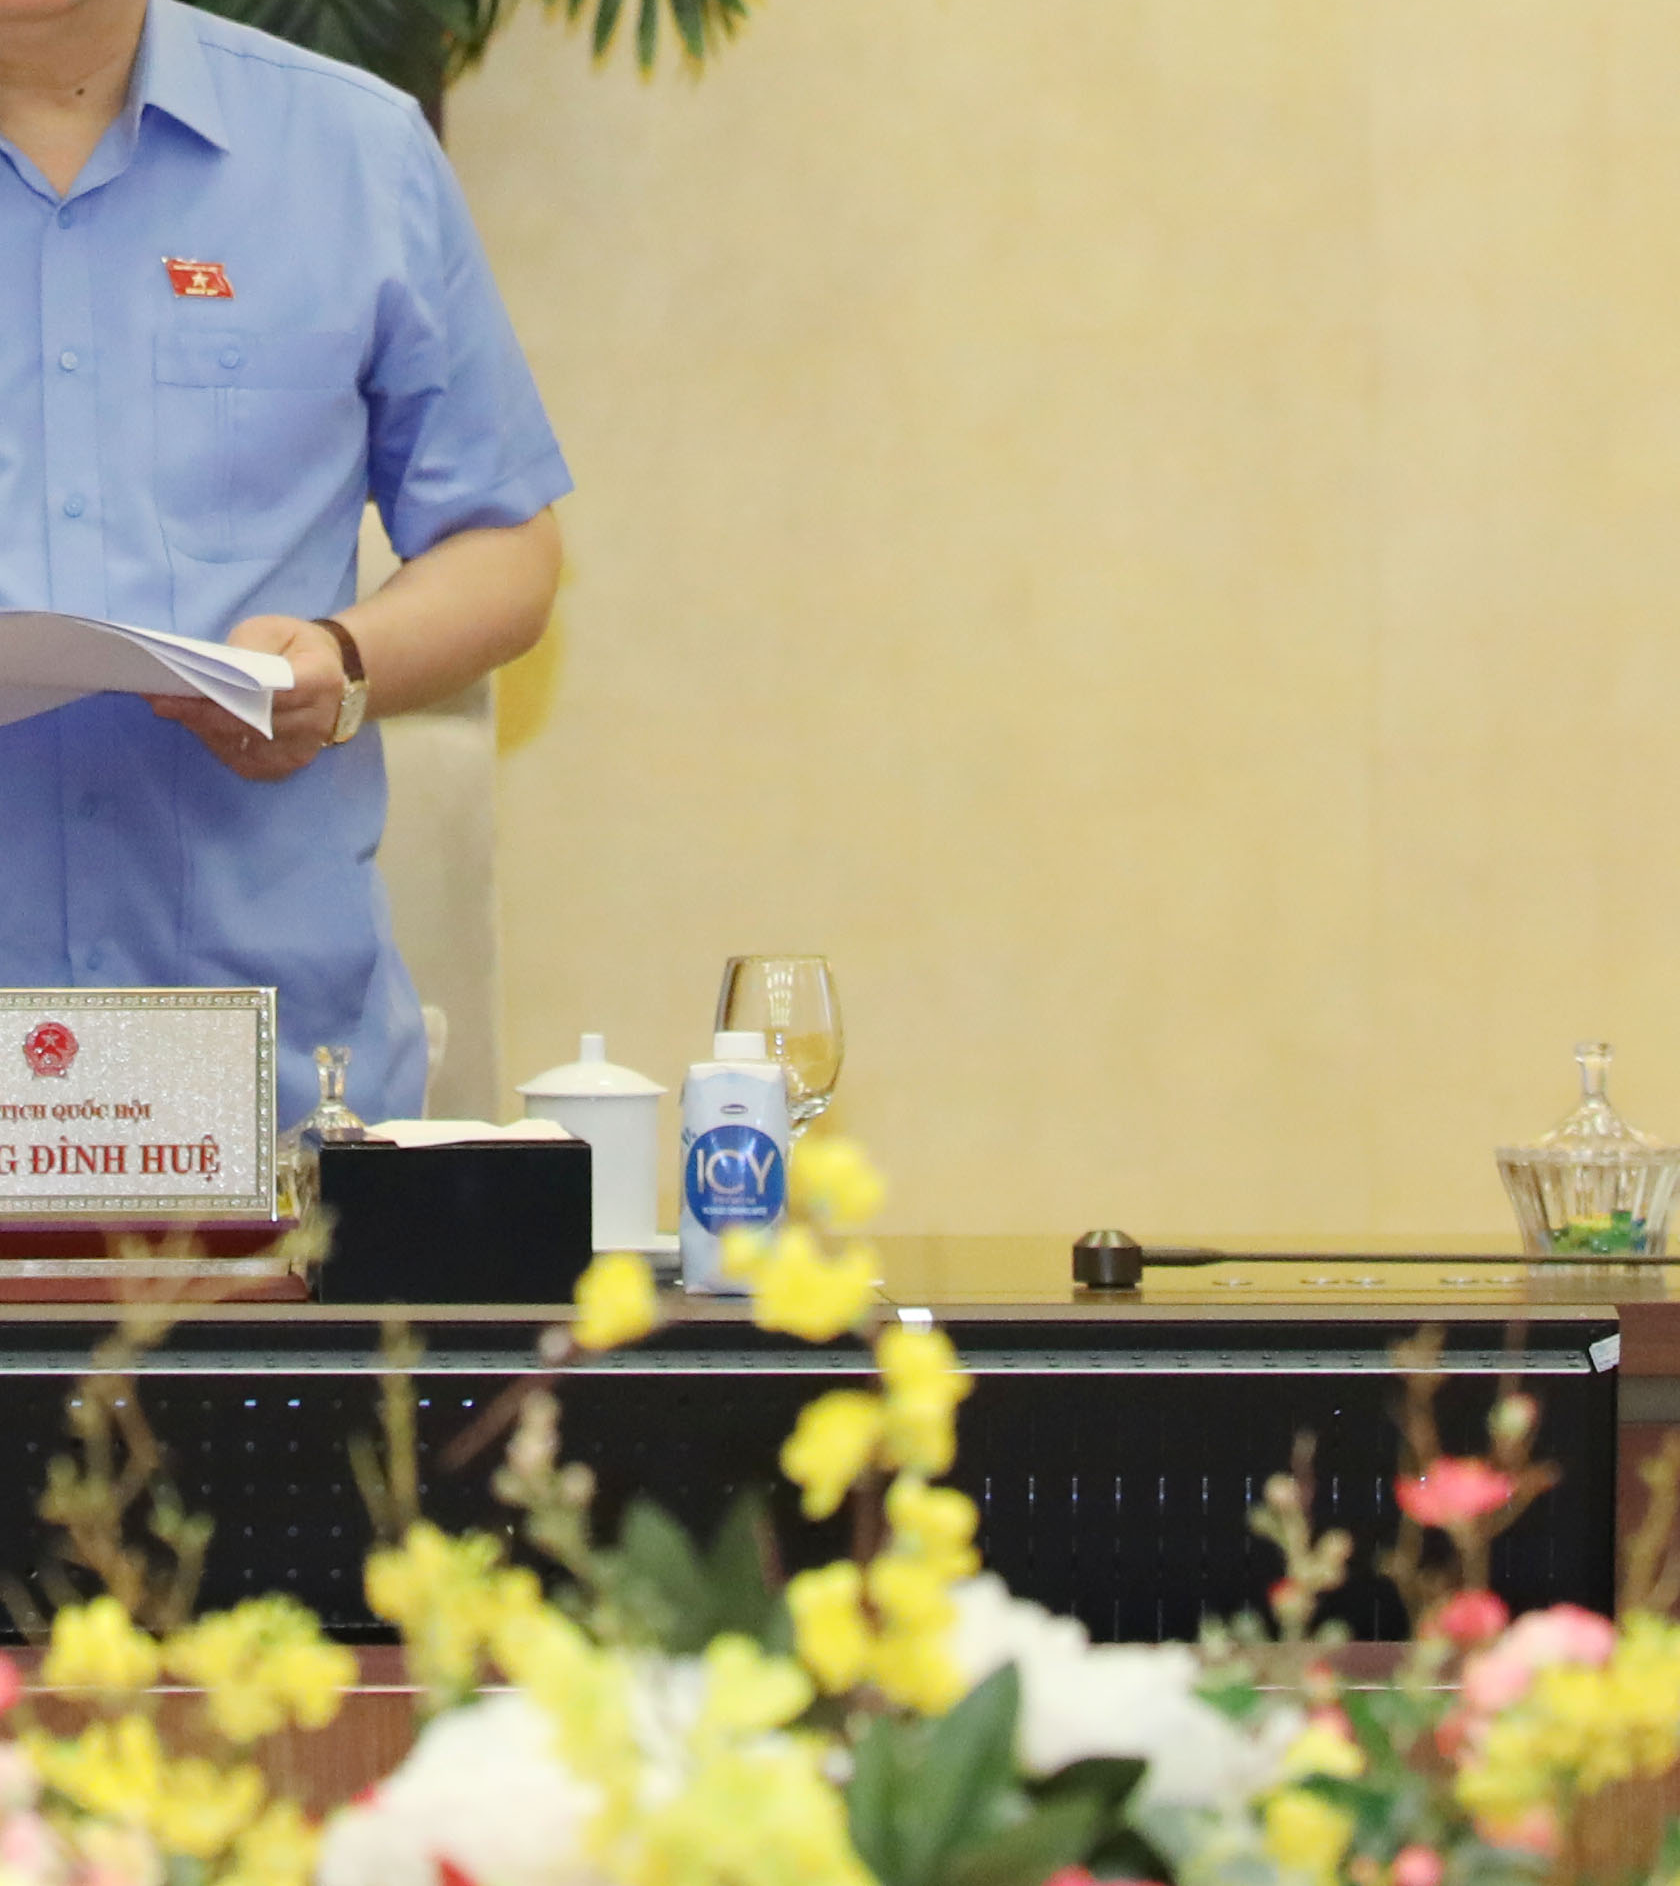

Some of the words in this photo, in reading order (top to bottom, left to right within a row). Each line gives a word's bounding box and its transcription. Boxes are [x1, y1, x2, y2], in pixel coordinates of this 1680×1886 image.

[52, 1098, 109, 1123] QUỐC
[114, 1099, 152, 1123] HỘI
[29, 1135, 129, 1176] ĐÌNH
[139, 1134, 221, 1183] HUỆ
[696, 1148, 776, 1195] ICY
